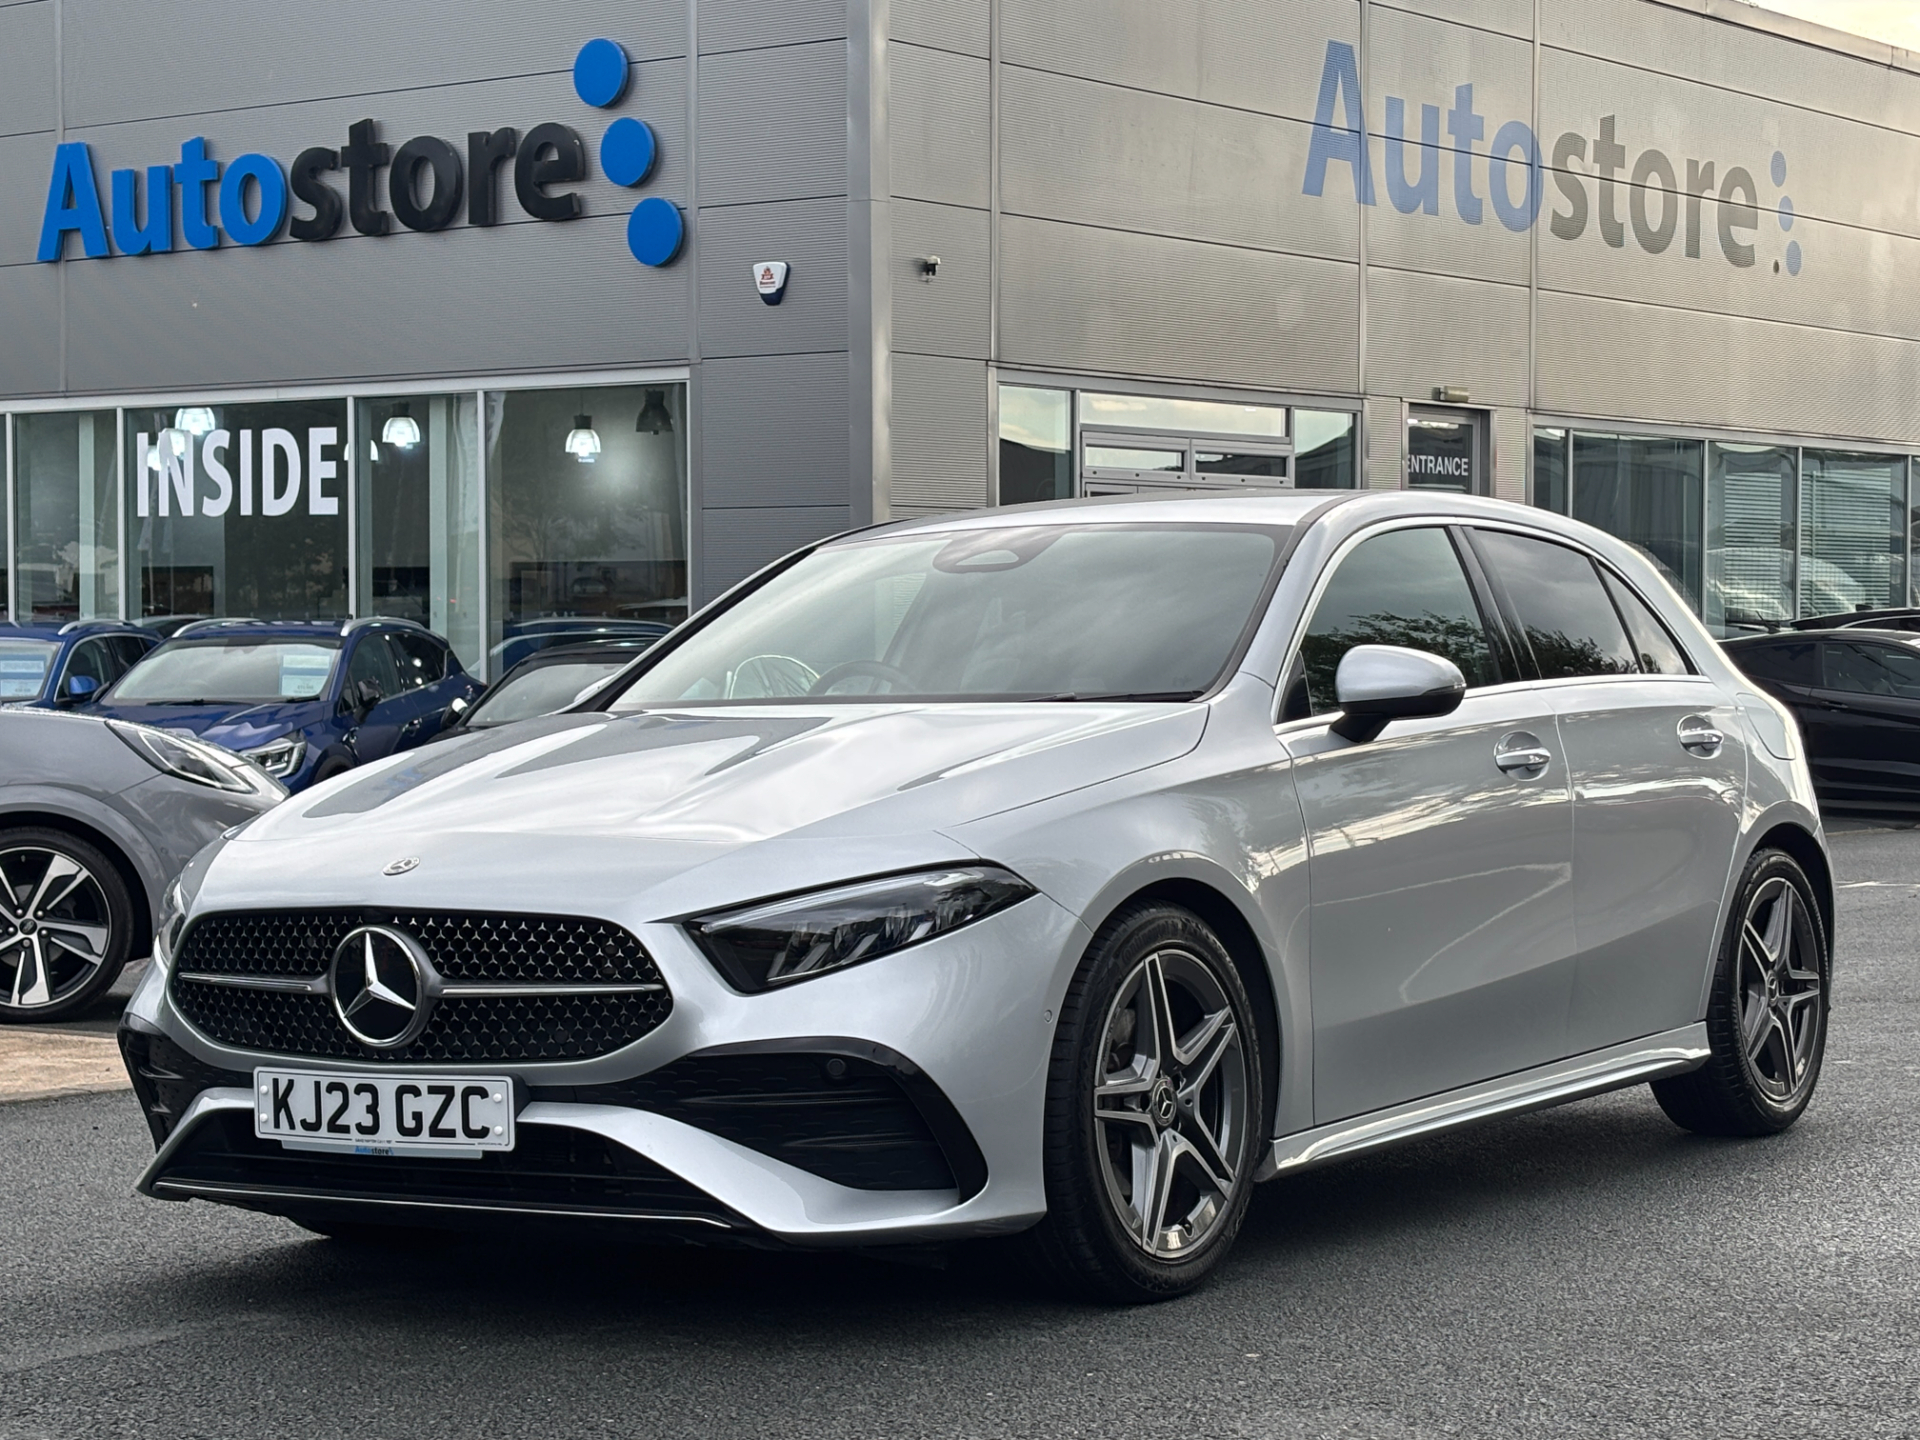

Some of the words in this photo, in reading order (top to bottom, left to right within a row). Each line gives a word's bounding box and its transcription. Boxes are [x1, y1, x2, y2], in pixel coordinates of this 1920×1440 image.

[36, 118, 586, 262] Autostore
[1302, 39, 1759, 268] Autostore
[137, 427, 339, 517] INSIDE
[271, 1077, 381, 1136] KJ23
[394, 1084, 491, 1139] GZC
